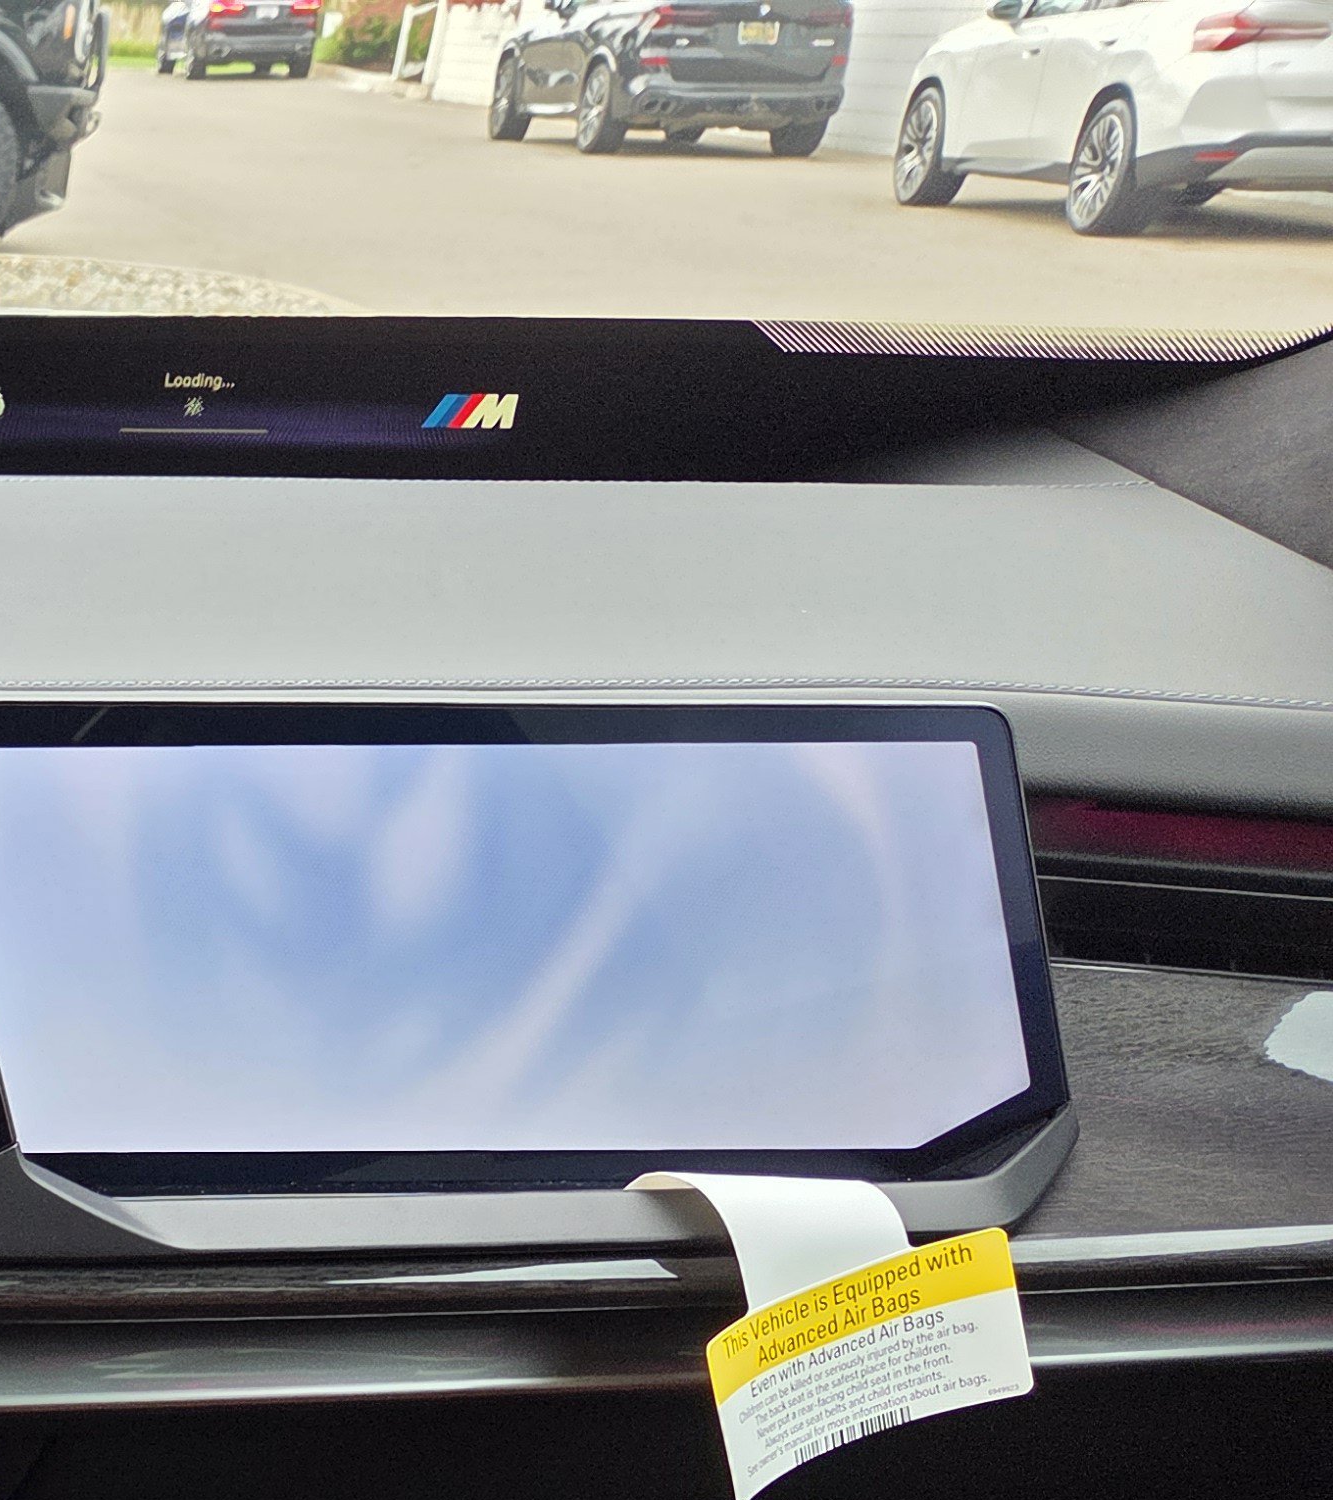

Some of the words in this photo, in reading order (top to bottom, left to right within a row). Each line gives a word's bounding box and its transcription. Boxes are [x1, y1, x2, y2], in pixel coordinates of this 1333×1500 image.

[163, 371, 236, 391] Loading...
[722, 1330, 749, 1359] This
[749, 1301, 809, 1340] Vehicle
[813, 1293, 828, 1313] is
[833, 1255, 921, 1306] Equipped
[925, 1243, 973, 1272] with
[758, 1313, 838, 1367] Advanced
[843, 1305, 867, 1330] Air
[871, 1289, 921, 1318] Bags
[749, 1373, 777, 1398] Even
[778, 1358, 806, 1382] with
[808, 1331, 876, 1368] Advanced
[879, 1322, 900, 1342] Air
[903, 1310, 945, 1333] Bags
[765, 1393, 779, 1406] can
[778, 1386, 790, 1399] be
[789, 1374, 813, 1392] killed
[813, 1371, 823, 1381] or
[824, 1354, 866, 1377] seriously
[867, 1340, 901, 1363] injured
[901, 1337, 915, 1350] by
[916, 1332, 934, 1345] the
[937, 1326, 951, 1339] air
[952, 1321, 979, 1335] bag.
[768, 1400, 787, 1418] back
[787, 1391, 806, 1409] seat
[806, 1388, 815, 1399] is
[815, 1382, 830, 1395] the
[831, 1369, 860, 1387] safest
[860, 1360, 887, 1379] place
[887, 1354, 902, 1367] for
[903, 1342, 951, 1362] children.
[777, 1412, 791, 1430] put
[791, 1411, 797, 1420] a
[797, 1389, 846, 1418] rear-facing
[845, 1380, 869, 1396] child
[870, 1371, 891, 1388] seat
[892, 1367, 903, 1379] in
[904, 1363, 922, 1376] the
[923, 1354, 954, 1370] front.
[789, 1420, 805, 1436] use
[805, 1410, 824, 1427] seat
[824, 1403, 848, 1419] belts
[848, 1394, 866, 1410] and
[867, 1385, 891, 1402] child
[893, 1371, 947, 1394] restraints.
[813, 1423, 826, 1438] for
[826, 1414, 851, 1432] more
[852, 1395, 909, 1420] information
[909, 1383, 941, 1402] about
[942, 1379, 957, 1393] air
[958, 1373, 992, 1389] bags.
